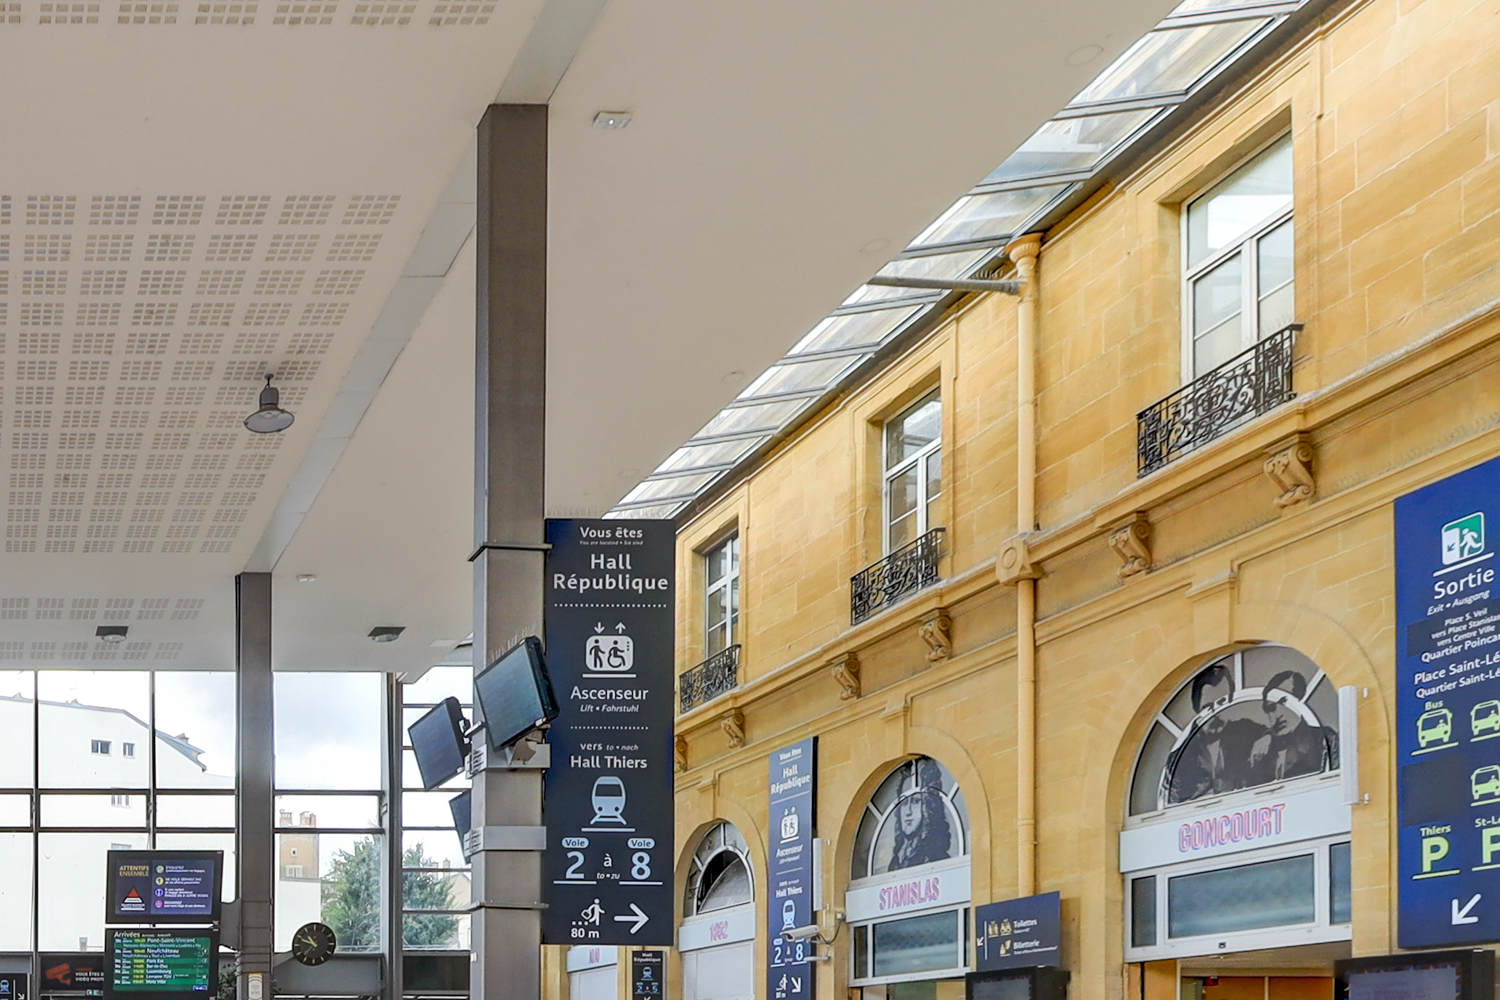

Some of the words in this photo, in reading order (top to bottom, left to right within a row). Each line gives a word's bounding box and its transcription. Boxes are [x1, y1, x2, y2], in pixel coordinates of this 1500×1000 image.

[580, 526, 612, 538] Vous
[615, 527, 643, 538] êtes
[590, 554, 632, 570] Hall
[553, 573, 669, 594] République
[1434, 568, 1495, 600] Sortie
[1426, 603, 1445, 616] Exit
[1451, 590, 1490, 608] Ausgang
[1444, 616, 1464, 627] Place
[1473, 607, 1488, 618] Veil
[1431, 630, 1447, 640] vers
[1447, 624, 1467, 635] Place
[1437, 638, 1452, 647] vers
[1453, 631, 1477, 642] Centre
[1478, 625, 1496, 635] Ville
[1421, 644, 1463, 663] Quartier
[1414, 669, 1446, 685] Place
[570, 686, 649, 700] Ascenseur
[1416, 681, 1458, 699] Quartier
[580, 704, 594, 713] Lift
[601, 704, 639, 713] Fahrstuhl
[1425, 700, 1444, 711] Bus
[580, 743, 603, 751] vers
[621, 743, 639, 751] nach
[570, 755, 601, 768] Hall
[604, 755, 648, 769] Thiers
[783, 764, 798, 779] Hall
[771, 774, 810, 794] République
[1179, 803, 1286, 852] GONCOURT
[1420, 825, 1452, 837] Thiers
[565, 839, 585, 847] Voie
[631, 840, 651, 848] Voie
[1422, 836, 1449, 873] P
[566, 851, 584, 879] 2
[603, 853, 612, 867] à
[631, 851, 651, 880] 8
[597, 872, 606, 880] to
[879, 877, 940, 911] STANISLAS
[1013, 919, 1038, 928] Toilettes
[571, 928, 585, 938] 80
[588, 930, 600, 938] m
[774, 946, 781, 963] 2
[796, 943, 804, 961] 8
[1013, 940, 1040, 950] Billetterie
[637, 985, 643, 993] 2
[652, 985, 658, 993] 5
